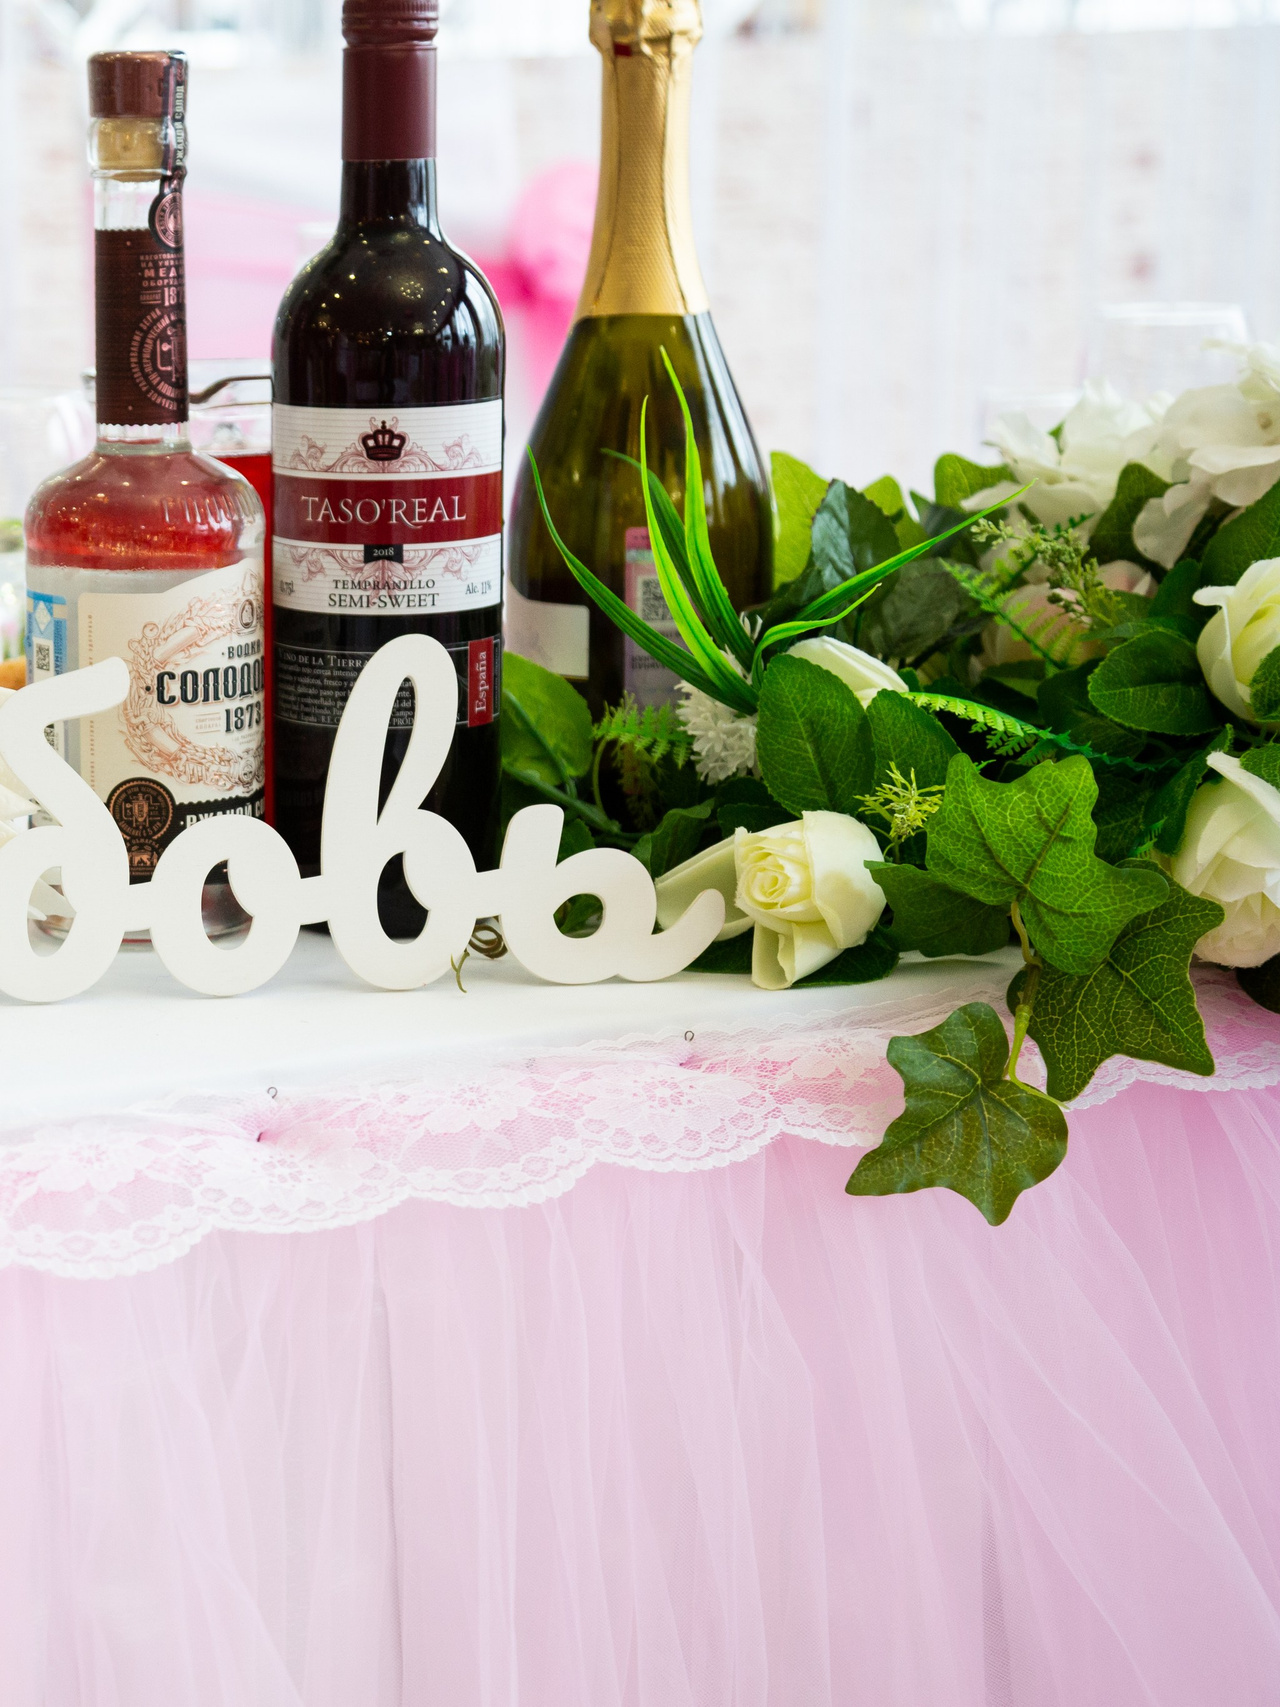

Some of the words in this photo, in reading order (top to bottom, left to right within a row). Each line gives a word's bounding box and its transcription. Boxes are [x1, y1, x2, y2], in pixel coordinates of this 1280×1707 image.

[301, 495, 467, 529] TASO'REAL
[373, 547, 395, 557] 2018
[332, 578, 436, 590] TEMPRANILLO
[327, 593, 440, 609] SEMI-SWEET
[298, 655, 310, 664] DE
[312, 656, 325, 666] LA
[333, 668, 358, 677] intenso
[323, 677, 342, 686] fresco
[475, 651, 489, 714] España
[334, 690, 346, 698] por
[224, 700, 262, 734] 1873
